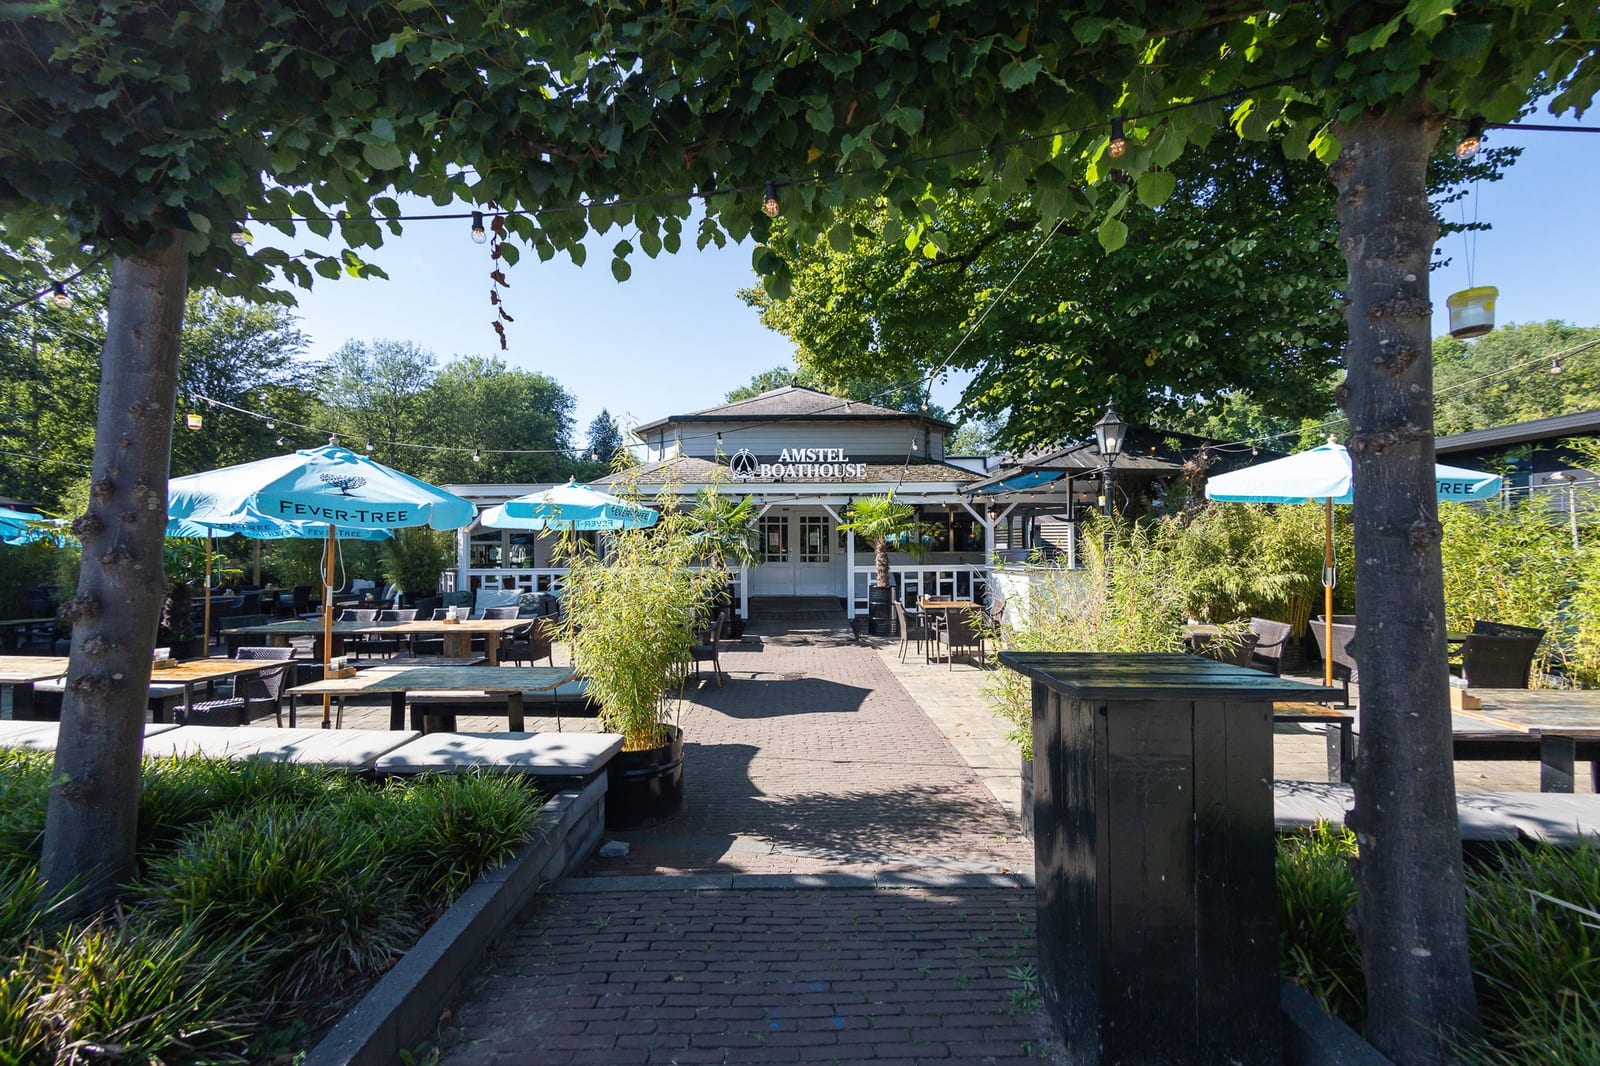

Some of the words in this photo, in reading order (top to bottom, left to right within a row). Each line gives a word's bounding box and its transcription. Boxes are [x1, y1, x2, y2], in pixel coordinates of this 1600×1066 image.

[778, 448, 848, 462] AMSTEL
[760, 463, 867, 478] BOATHOUSE
[1437, 481, 1475, 495] REE
[280, 500, 408, 523] FEVER-TREE
[308, 523, 361, 537] FEV-TREE
